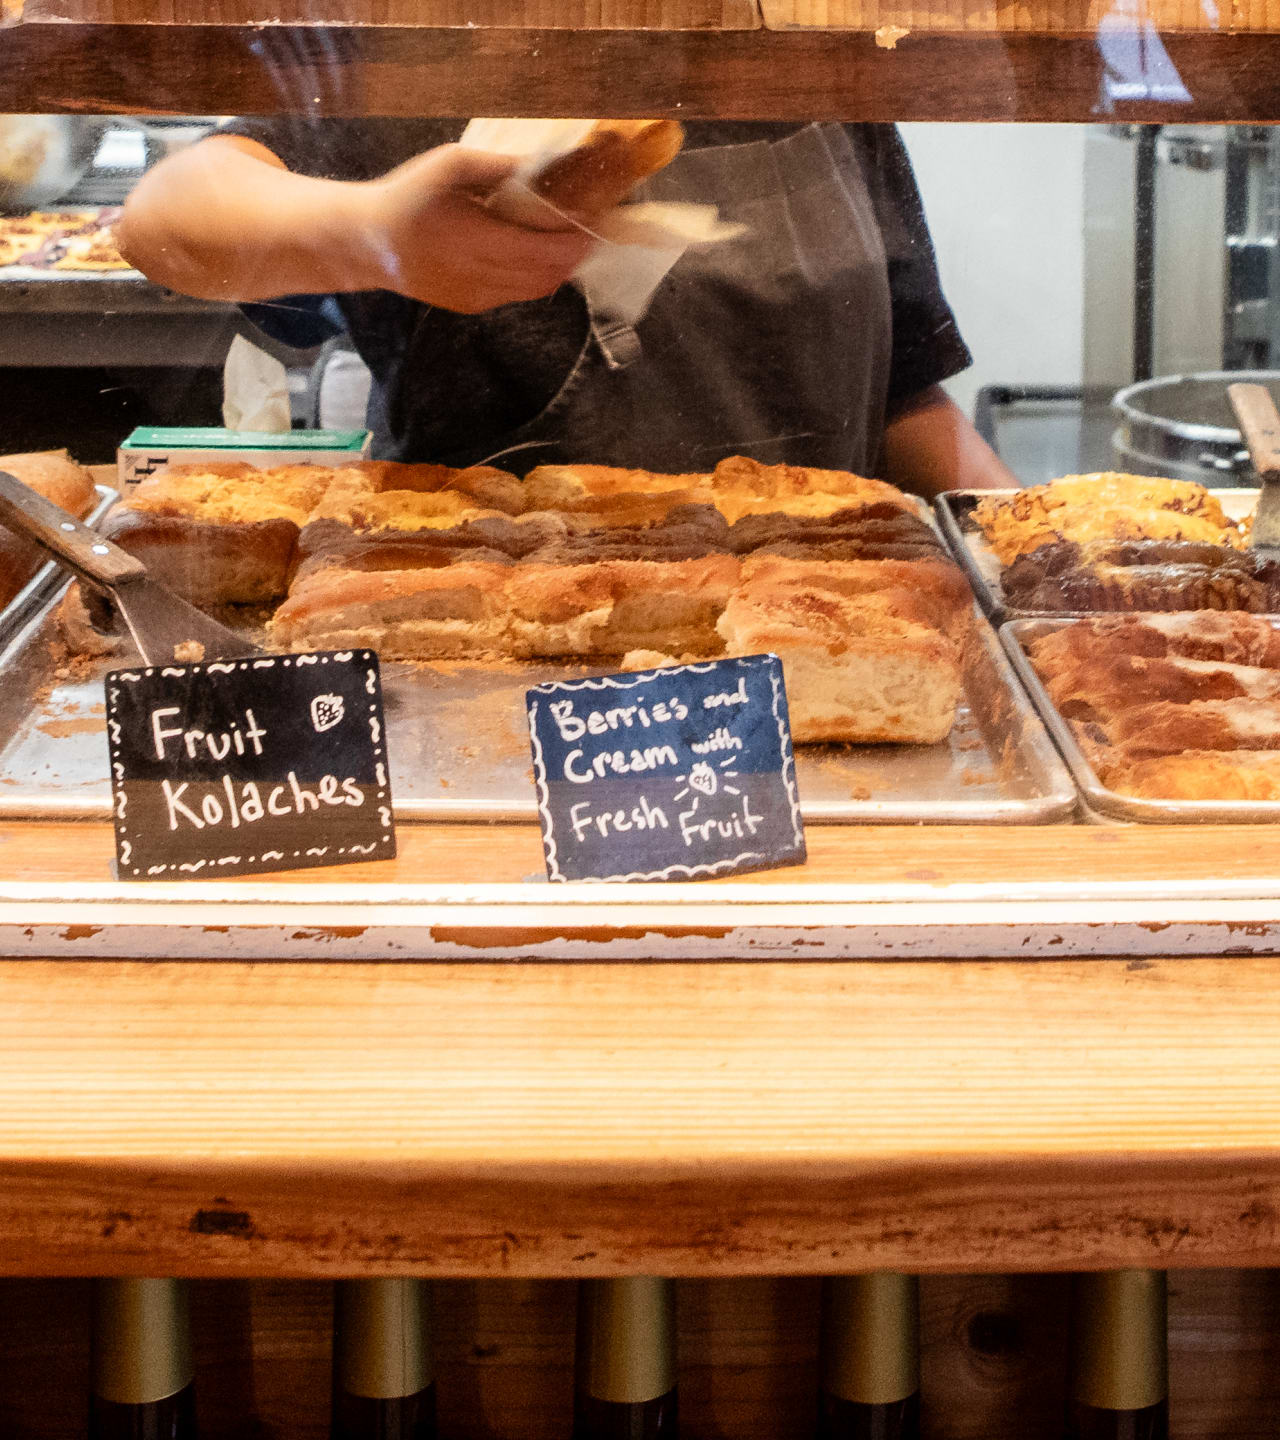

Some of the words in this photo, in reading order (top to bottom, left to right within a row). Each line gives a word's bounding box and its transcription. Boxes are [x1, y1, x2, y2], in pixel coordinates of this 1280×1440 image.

[703, 676, 749, 709] and
[152, 707, 267, 760] Fruit
[564, 744, 678, 784] Cream
[691, 727, 742, 754] with
[161, 770, 365, 831] Kolaches
[570, 795, 669, 842] Fresh
[678, 795, 764, 846] Fruit
